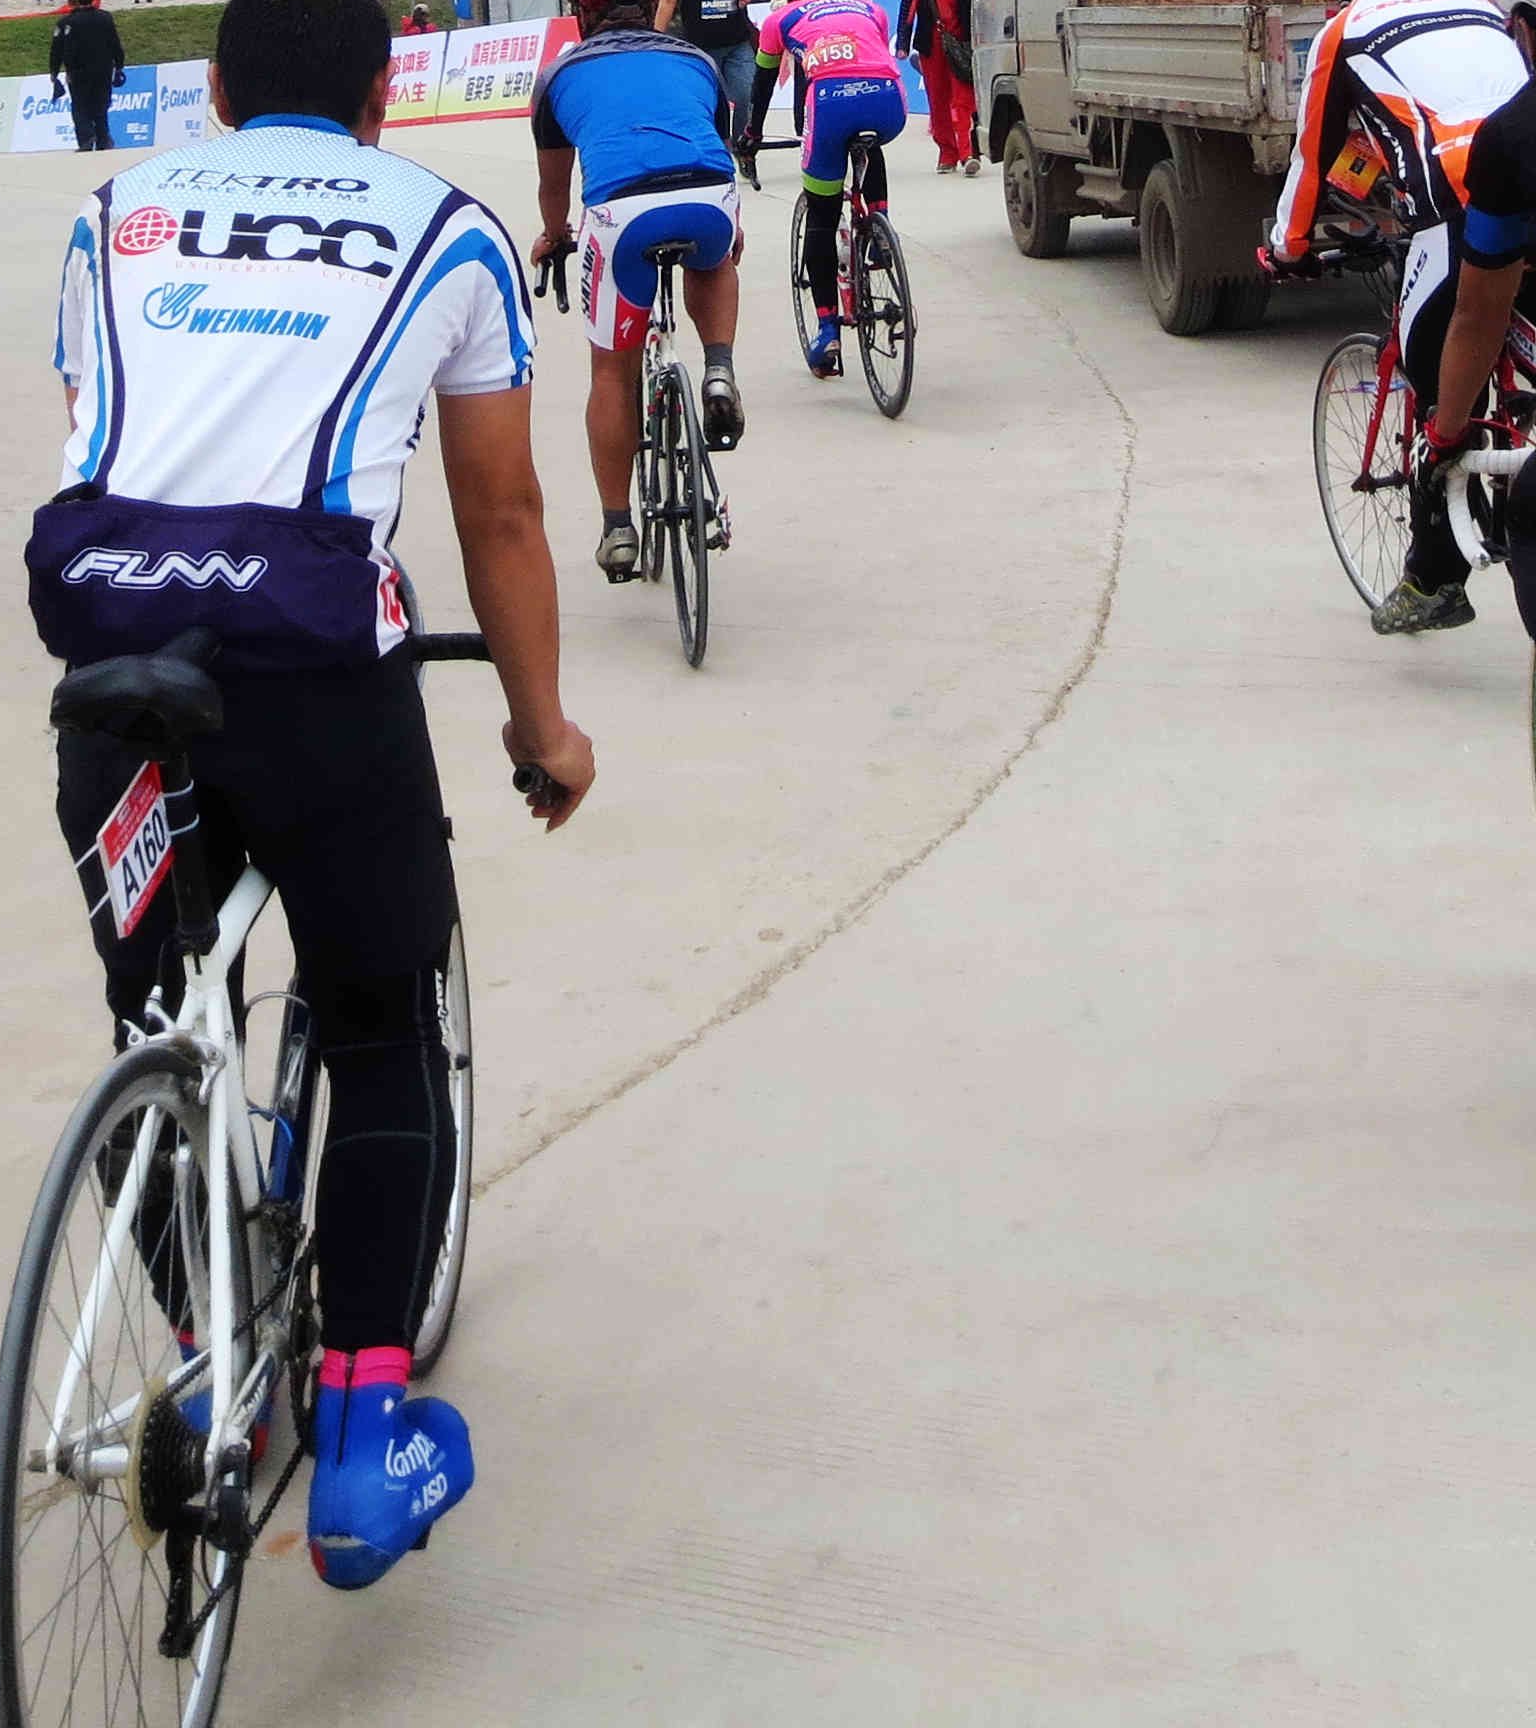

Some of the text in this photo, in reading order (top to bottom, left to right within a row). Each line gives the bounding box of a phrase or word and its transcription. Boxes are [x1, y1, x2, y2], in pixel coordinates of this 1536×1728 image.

[169, 87, 204, 107] GIANT
[157, 182, 234, 194] BRAKE
[163, 167, 371, 193] TEKTRO
[177, 209, 398, 279] UCC
[187, 307, 331, 341] WEINMANN
[121, 807, 166, 910] A160
